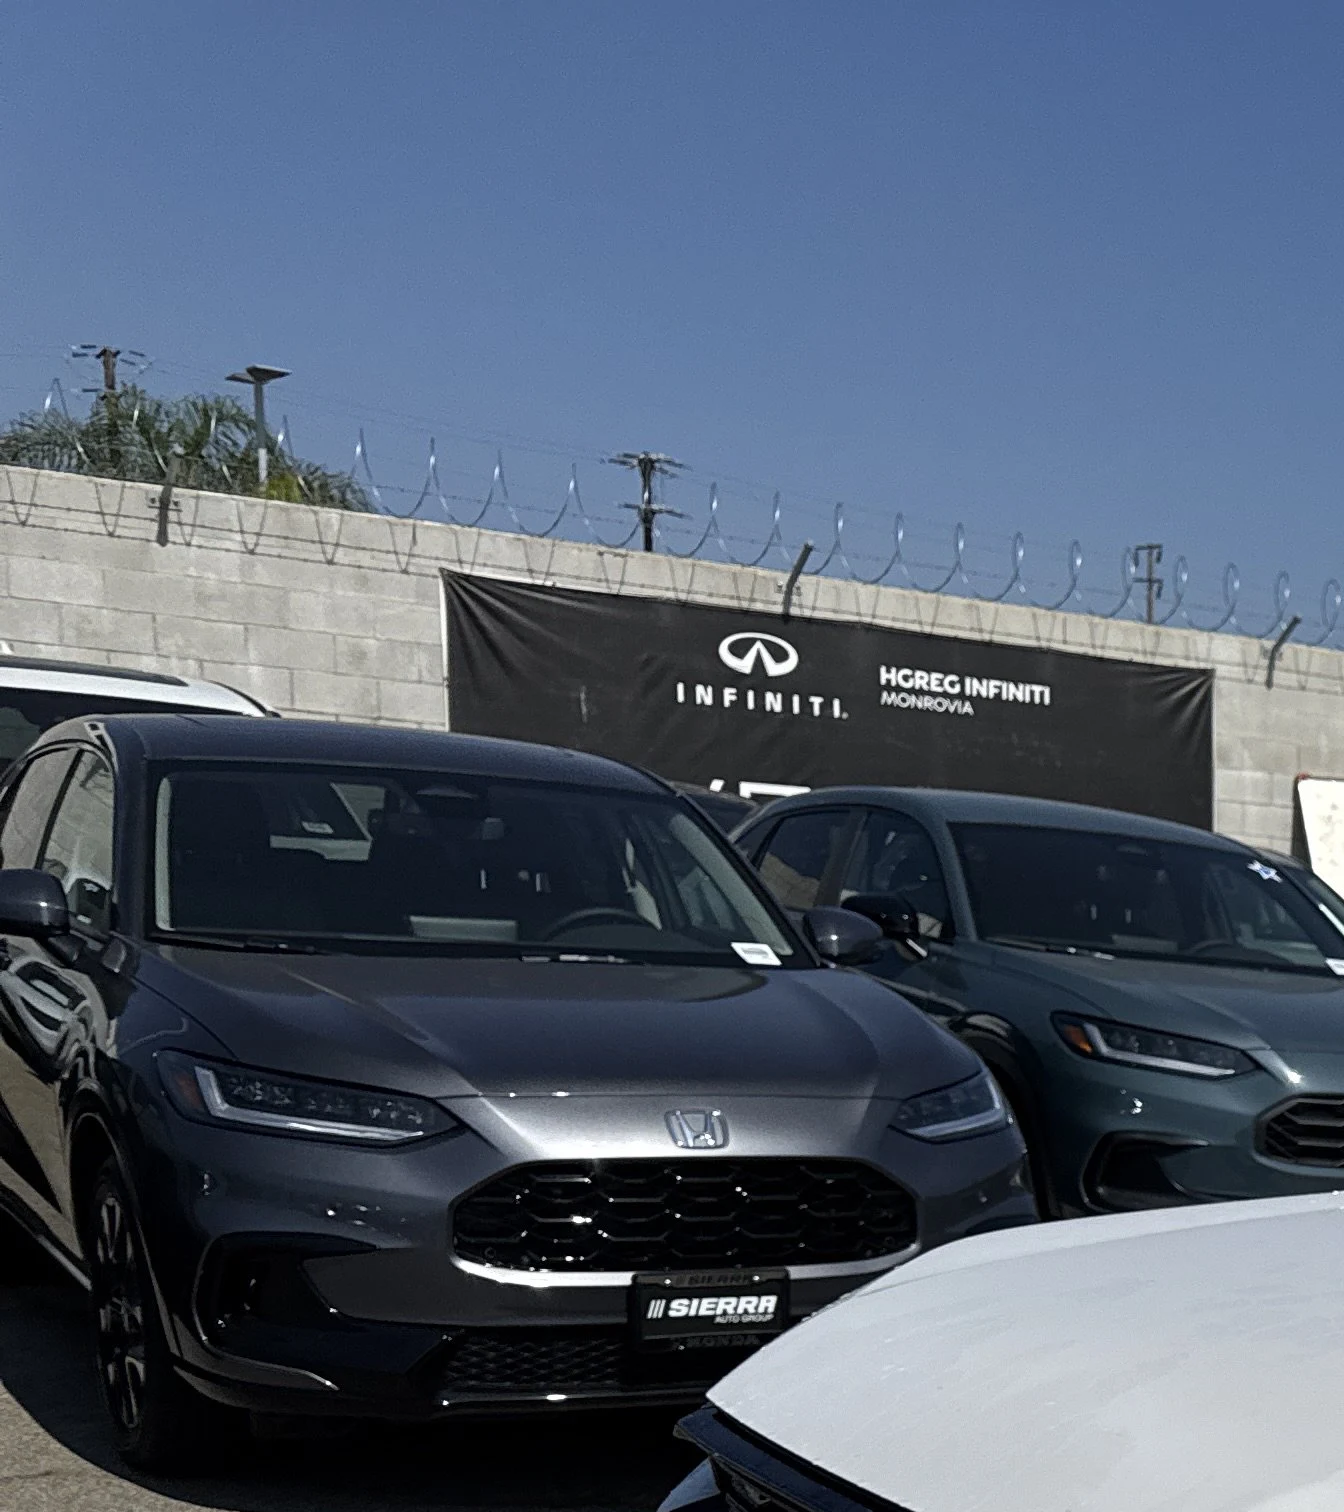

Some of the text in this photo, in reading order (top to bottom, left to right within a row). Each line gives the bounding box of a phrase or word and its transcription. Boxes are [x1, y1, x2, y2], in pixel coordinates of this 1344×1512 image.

[879, 664, 1051, 706] HGREG INFINITI
[676, 681, 842, 719] INFINITI
[879, 690, 975, 717] MONROVIA
[667, 1294, 778, 1318] SIERRA
[713, 1313, 775, 1324] AUTO GROUP
